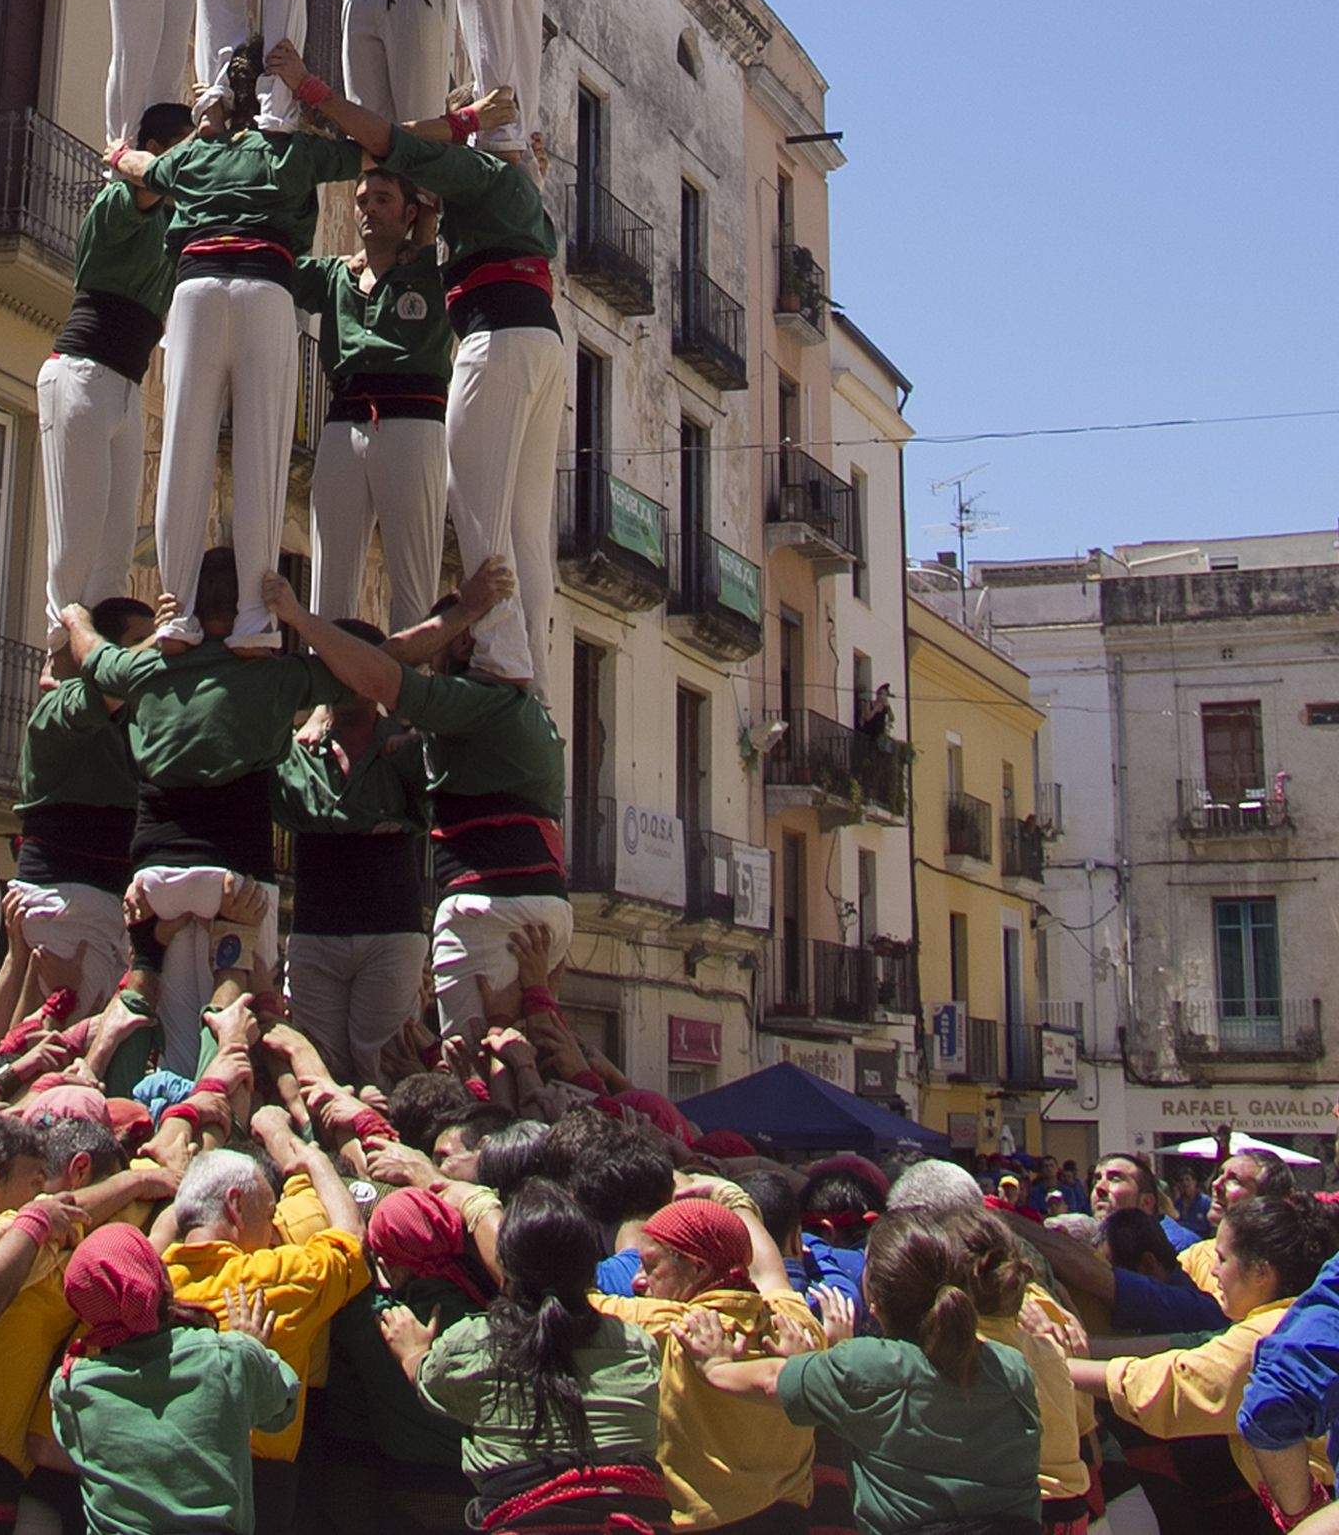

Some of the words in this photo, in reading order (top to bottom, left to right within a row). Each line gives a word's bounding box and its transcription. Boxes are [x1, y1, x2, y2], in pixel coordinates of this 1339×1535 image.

[1162, 1100, 1238, 1116] RAFAEL
[1248, 1096, 1335, 1117] GAVALDÀ
[1266, 1119, 1320, 1129] VILANOVA
